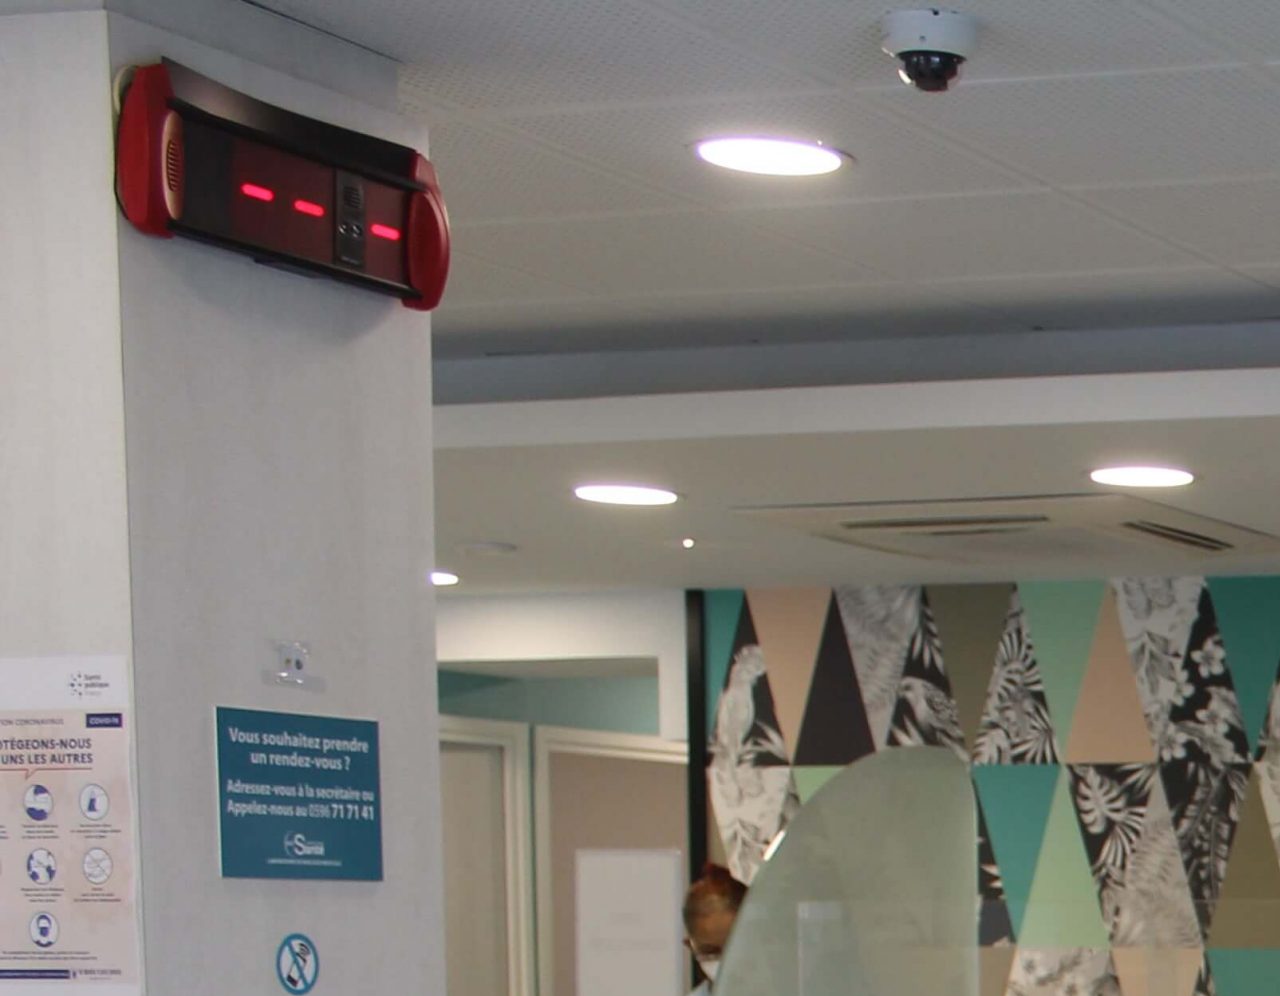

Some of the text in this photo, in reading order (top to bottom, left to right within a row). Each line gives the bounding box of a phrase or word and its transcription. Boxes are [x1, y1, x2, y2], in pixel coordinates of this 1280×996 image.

[228, 727, 369, 754] Vous souhaitez prendre
[1, 753, 94, 765] UNS LES AUTRES
[251, 752, 267, 765] un
[269, 752, 342, 770] rendez-vous
[226, 779, 296, 797] Adressez-vous
[305, 784, 315, 798] la
[362, 791, 374, 802] ou
[226, 799, 294, 817] Appelez-nous
[332, 803, 345, 819] 71
[347, 804, 360, 820] 71
[361, 805, 375, 821] 41
